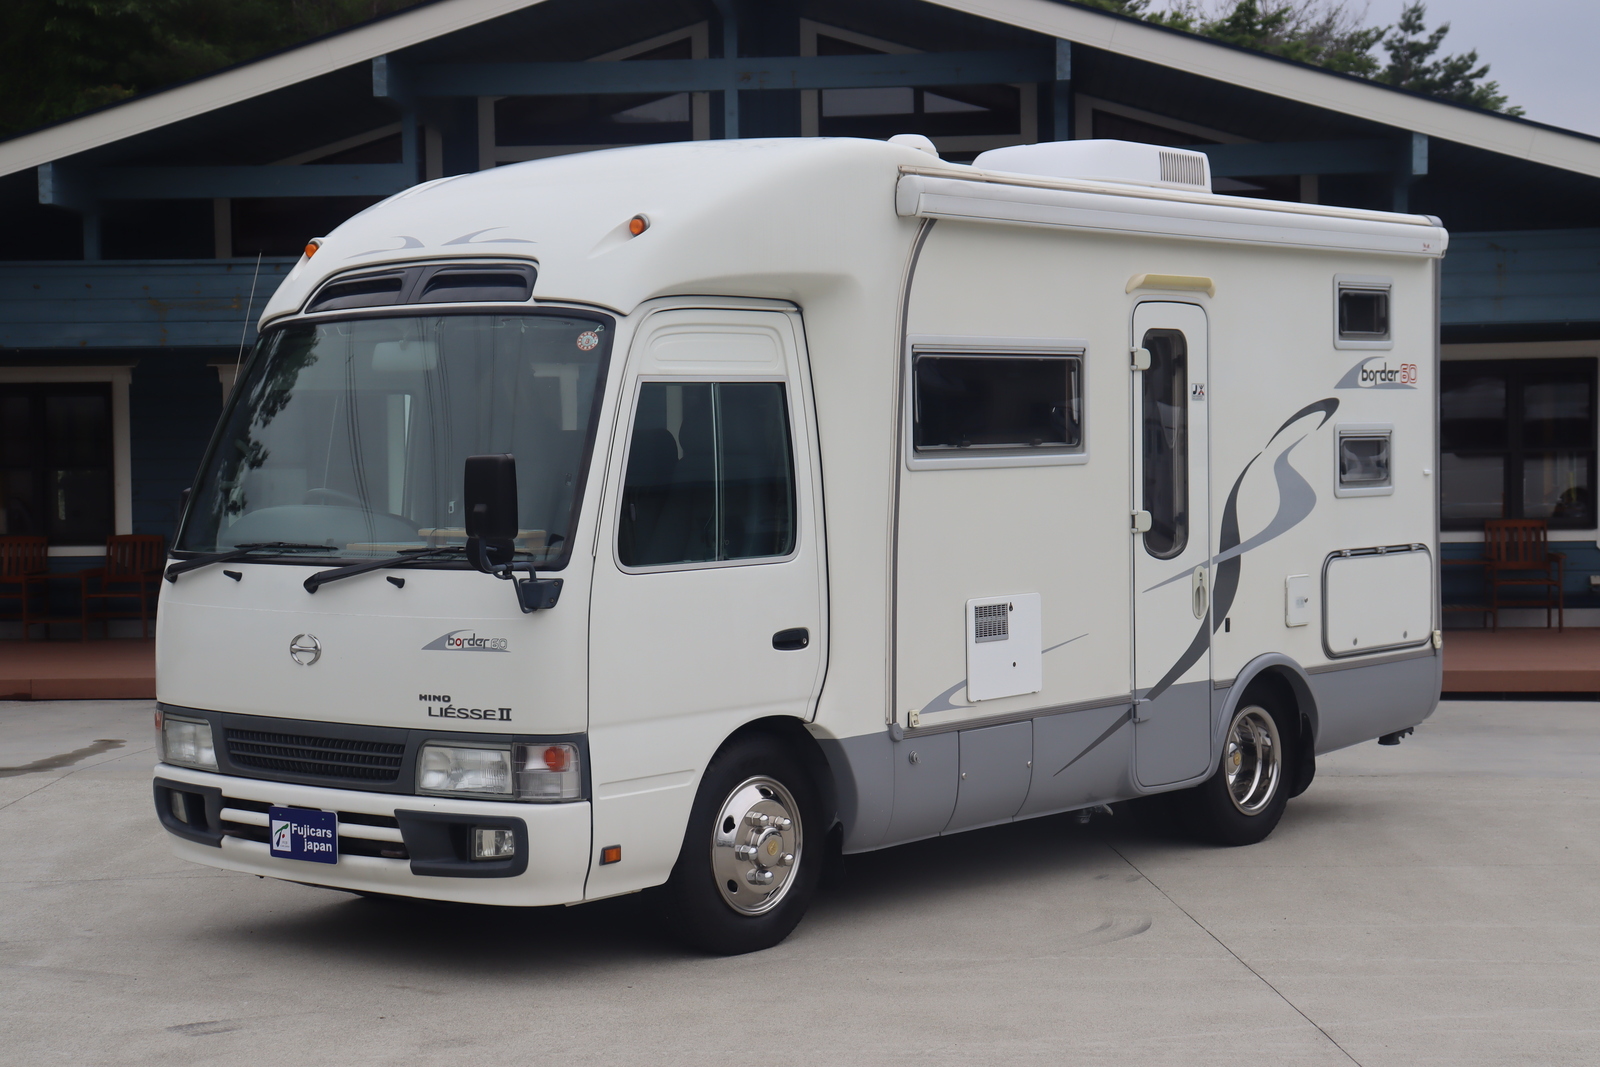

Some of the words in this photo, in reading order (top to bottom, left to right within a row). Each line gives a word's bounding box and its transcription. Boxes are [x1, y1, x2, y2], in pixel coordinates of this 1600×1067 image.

[419, 694, 451, 703] HINO
[291, 823, 333, 838] Fujicars
[303, 838, 333, 853] japan
